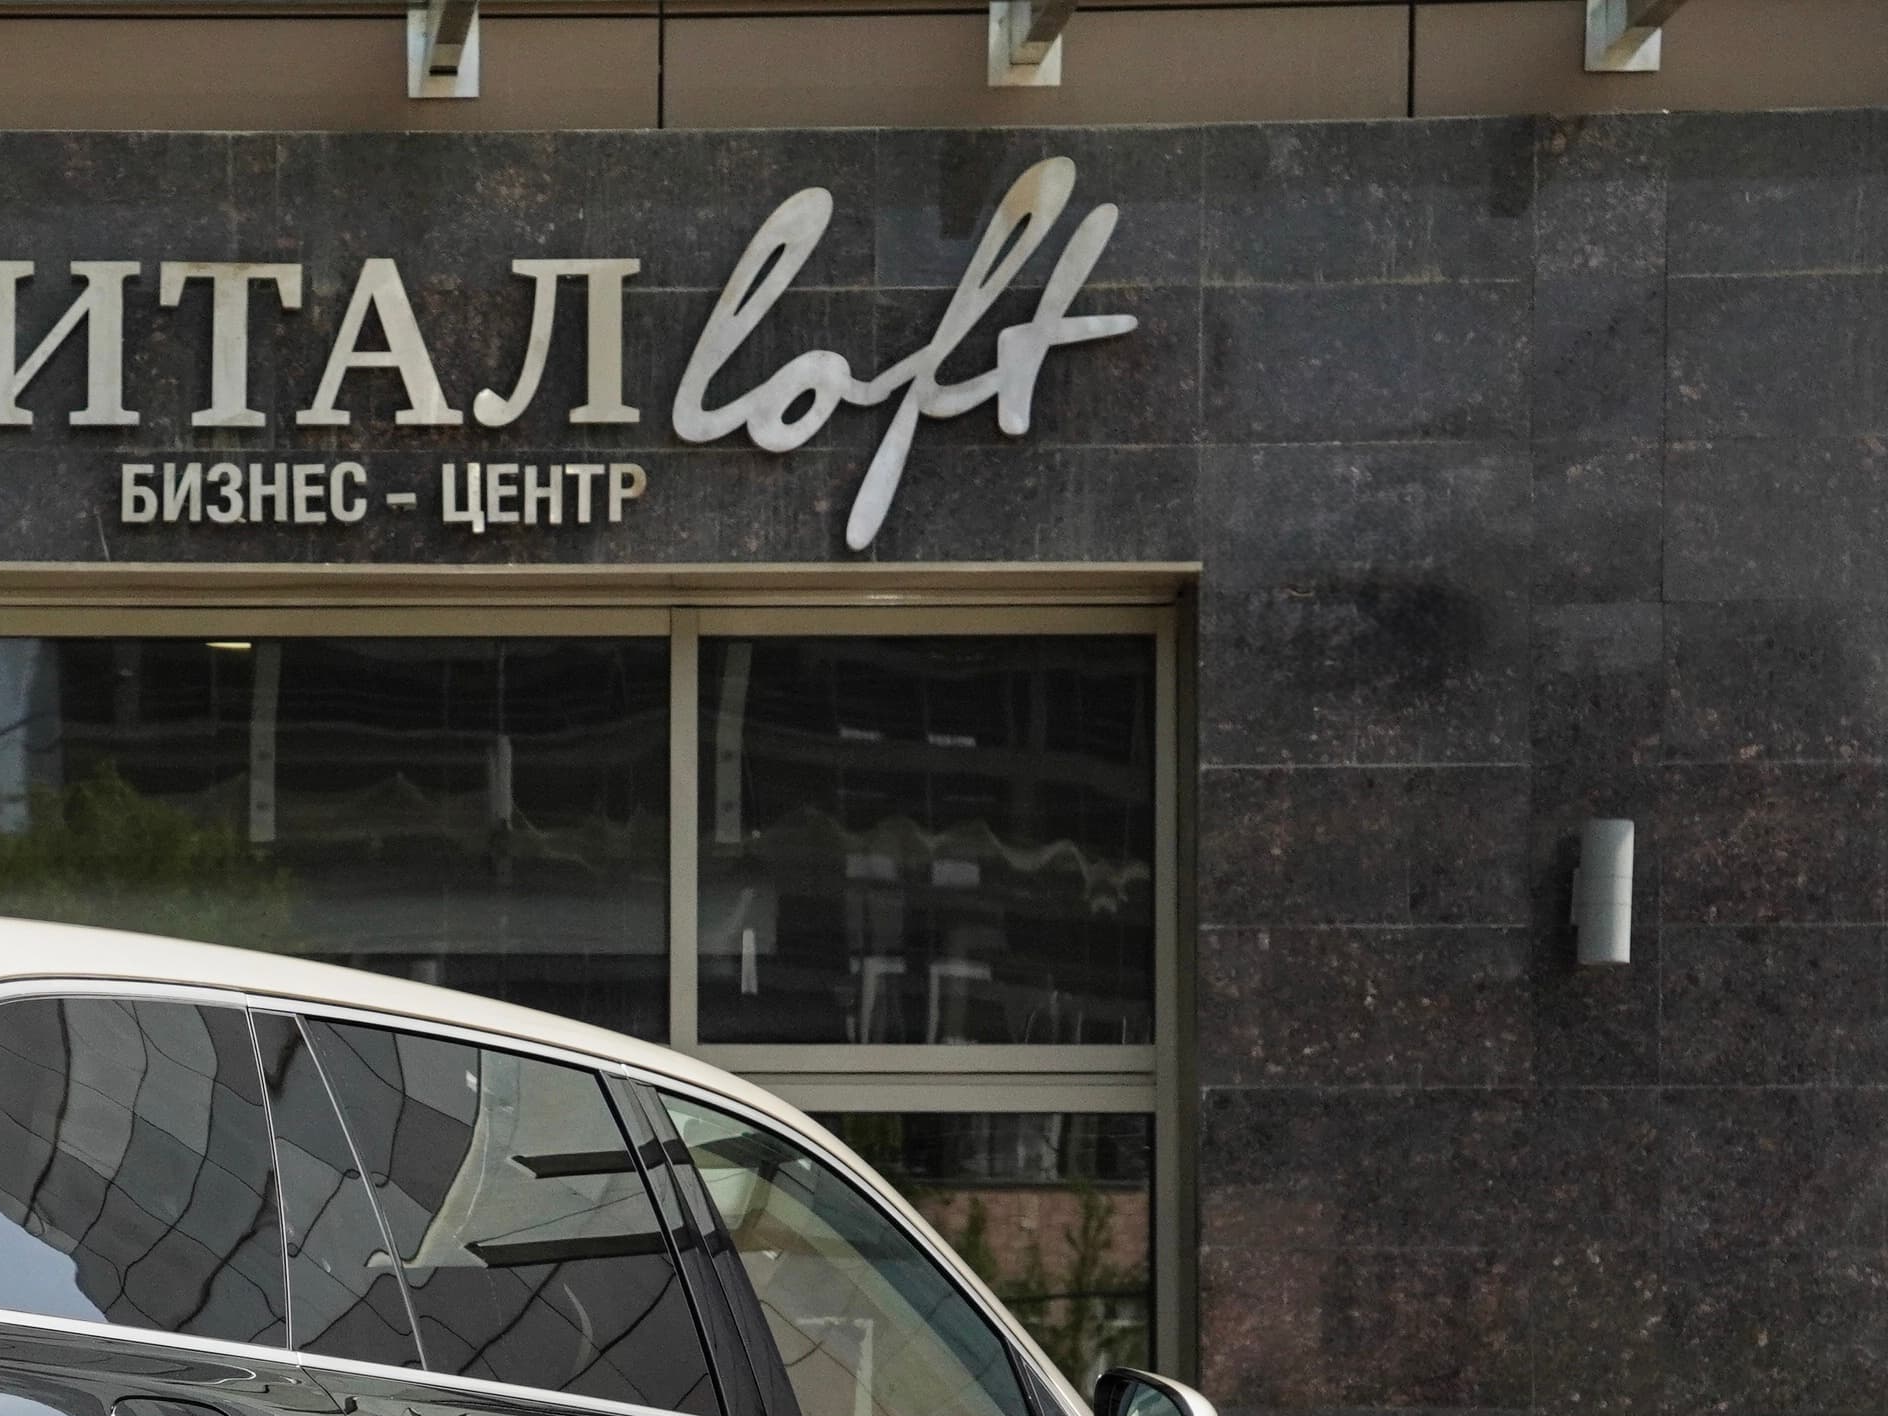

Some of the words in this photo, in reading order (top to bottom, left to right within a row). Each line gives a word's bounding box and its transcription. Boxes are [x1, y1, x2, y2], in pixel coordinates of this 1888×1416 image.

[672, 156, 1138, 551] loft
[120, 461, 368, 524] БИЗНЕС
[441, 462, 647, 534] ЦЕНТР
